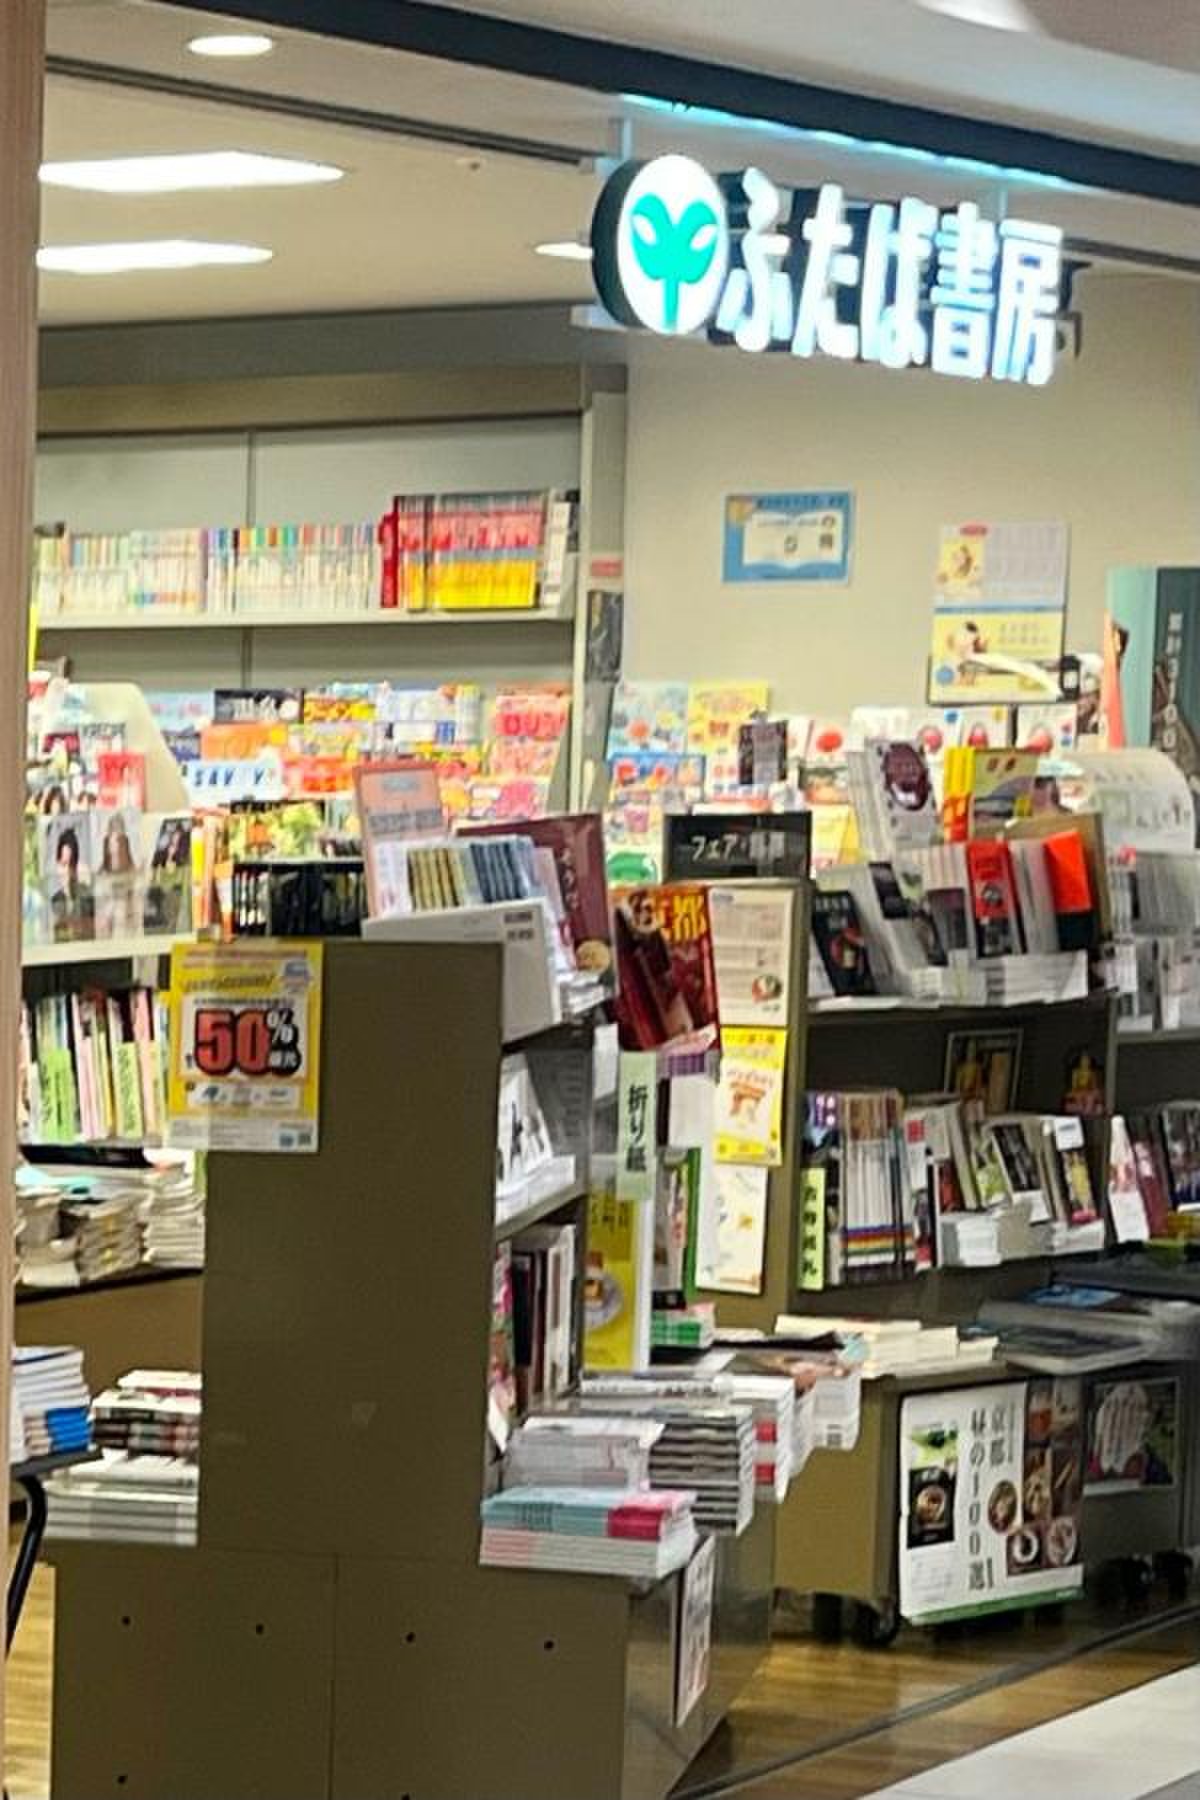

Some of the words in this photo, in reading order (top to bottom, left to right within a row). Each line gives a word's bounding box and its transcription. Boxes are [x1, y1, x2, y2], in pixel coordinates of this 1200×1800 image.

[716, 167, 1063, 386] ふたば書房
[626, 1085, 648, 1173] 折り紙
